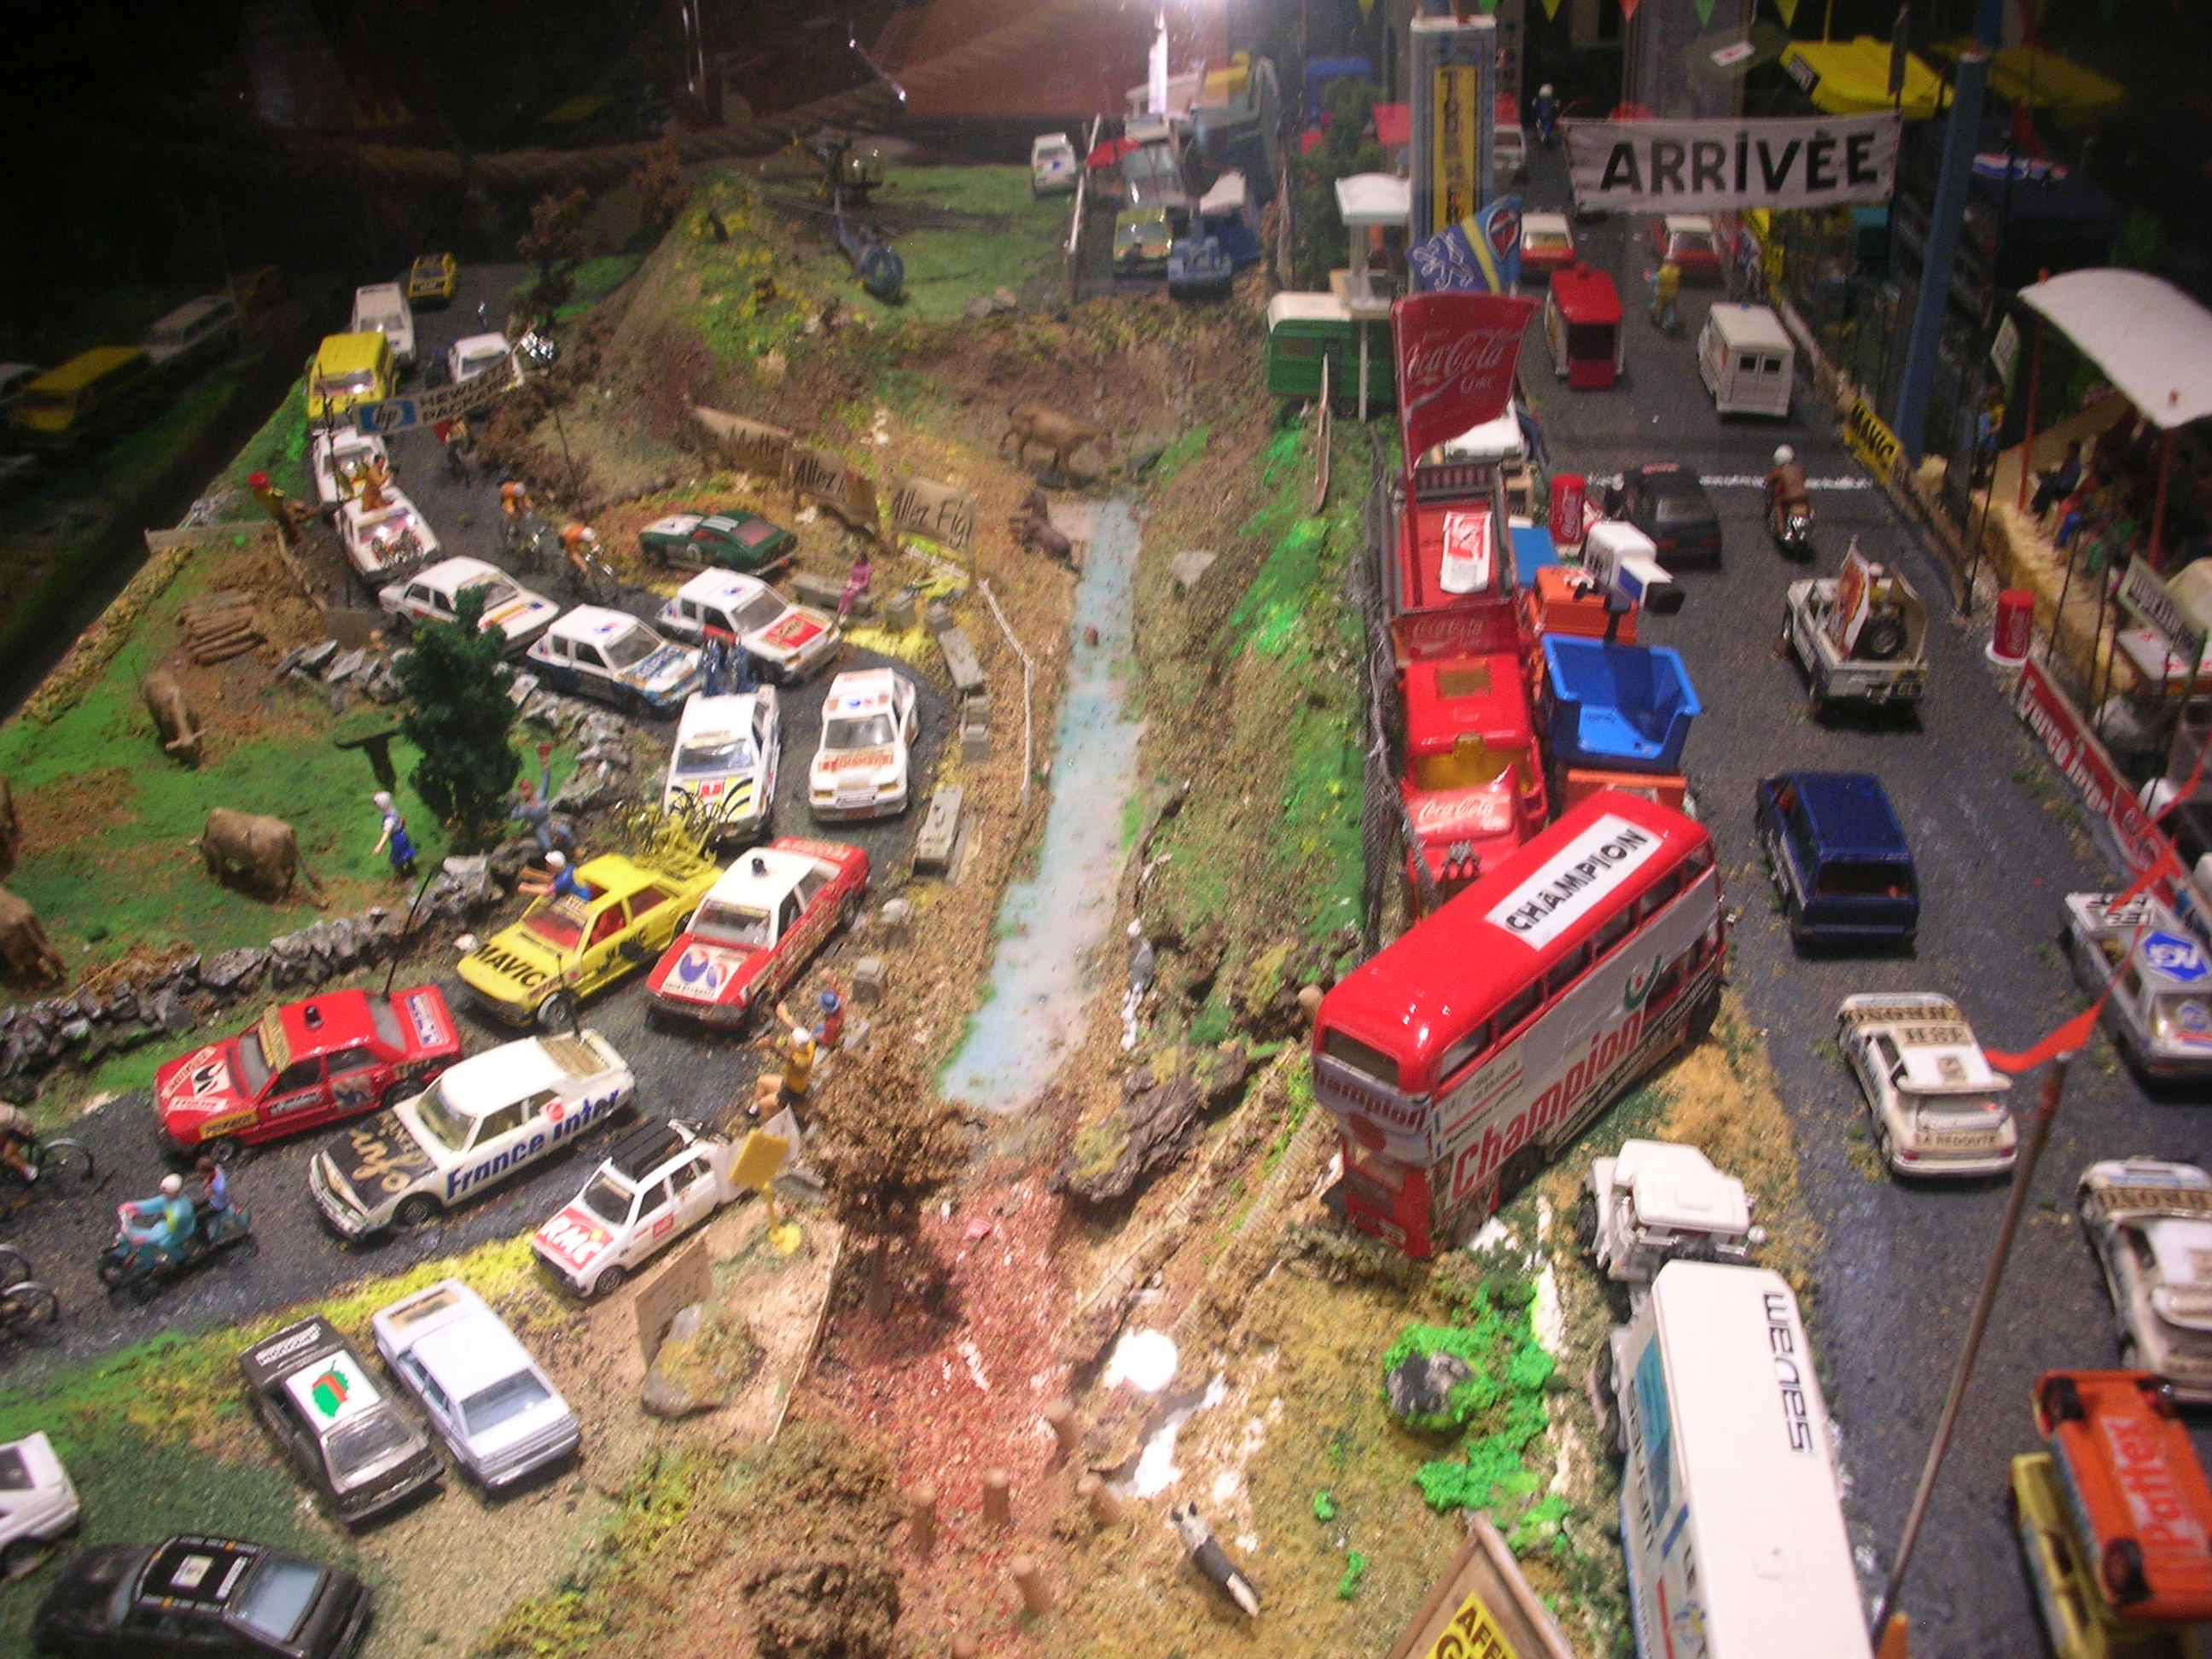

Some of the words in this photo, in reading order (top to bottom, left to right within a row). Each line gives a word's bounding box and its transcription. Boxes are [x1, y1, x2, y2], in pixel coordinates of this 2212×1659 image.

[1505, 824, 1650, 934] CHAMPION
[473, 942, 548, 987] MAVIC
[1452, 1009, 1643, 1192] Champion
[445, 1132, 545, 1200] France
[540, 1214, 604, 1264] RMC
